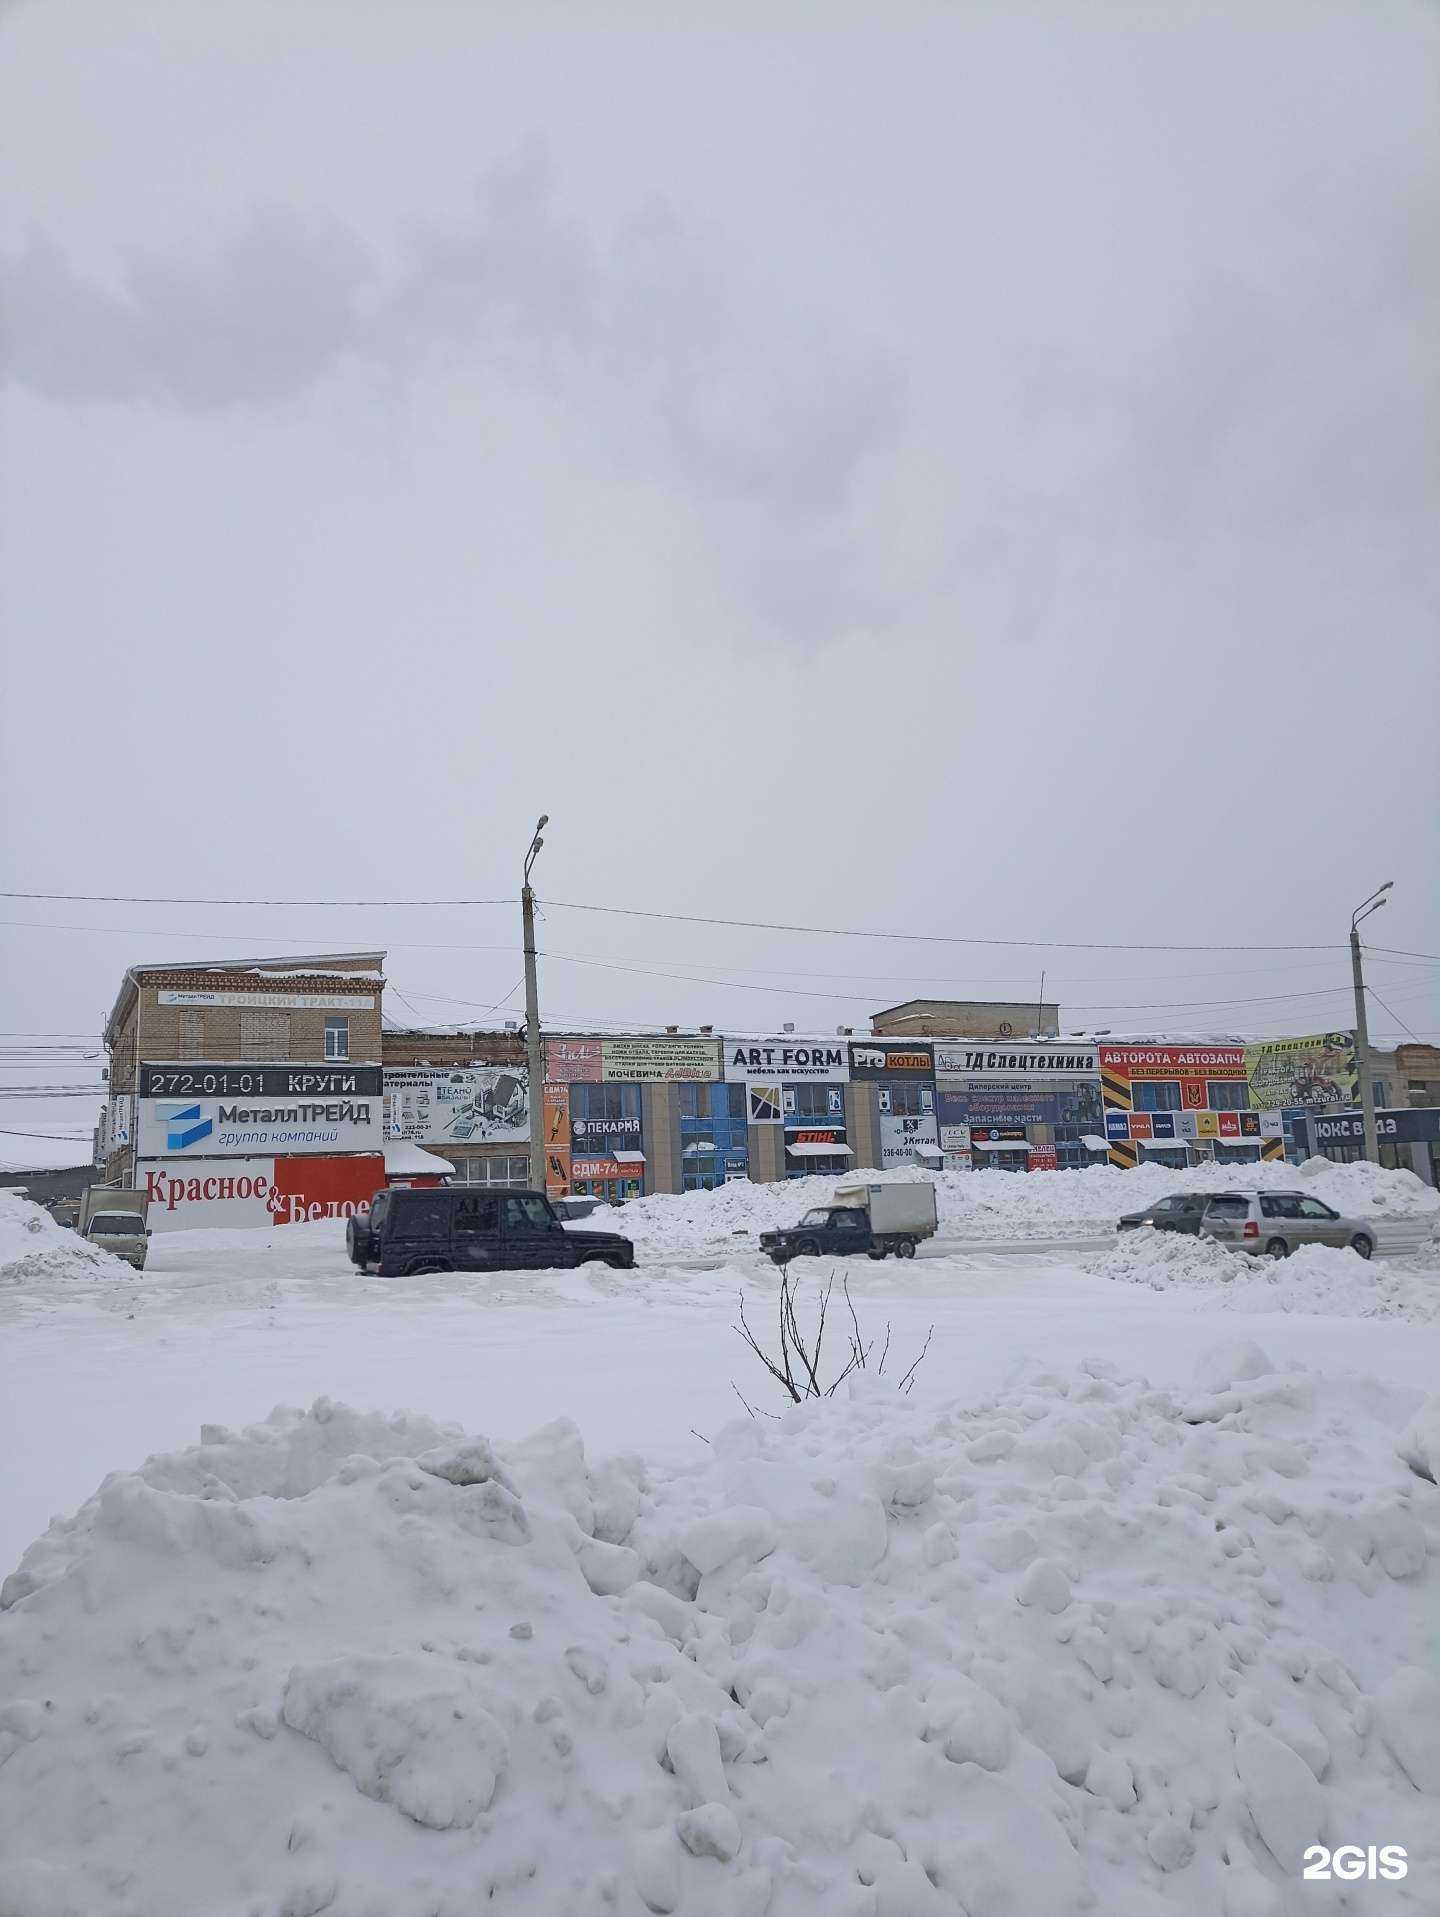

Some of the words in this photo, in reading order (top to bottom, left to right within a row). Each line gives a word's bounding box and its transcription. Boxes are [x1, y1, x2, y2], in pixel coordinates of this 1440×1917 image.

[733, 1048, 775, 1066] ART
[782, 1048, 843, 1066] FORM
[889, 1055, 930, 1068] КОТЛЫ
[965, 1052, 984, 1070] ТД
[987, 1052, 1094, 1071] Спецтехника
[1104, 1051, 1171, 1064] АВТОРОТА
[384, 1072, 450, 1080] троительные
[746, 1066, 775, 1075] мебель
[792, 1067, 829, 1076] искусство
[150, 1074, 265, 1094] 272-01-01
[287, 1074, 357, 1092] КРУГИ
[384, 1080, 433, 1088] атериалы
[1011, 1084, 1032, 1092] центр
[441, 1087, 472, 1095] ТЕХНО
[217, 1100, 371, 1126] МеталлТРЕЙД
[962, 1114, 1013, 1124] Запасные
[1014, 1114, 1043, 1124] части
[587, 1120, 640, 1133] ПЕКАРНЯ
[218, 1131, 267, 1147] группа
[271, 1128, 339, 1144] компаний
[796, 1132, 835, 1143] STIHL
[571, 1162, 619, 1177] СДМ-74
[144, 1170, 268, 1210] Красное
[265, 1185, 287, 1213] &
[288, 1193, 370, 1225] Белое
